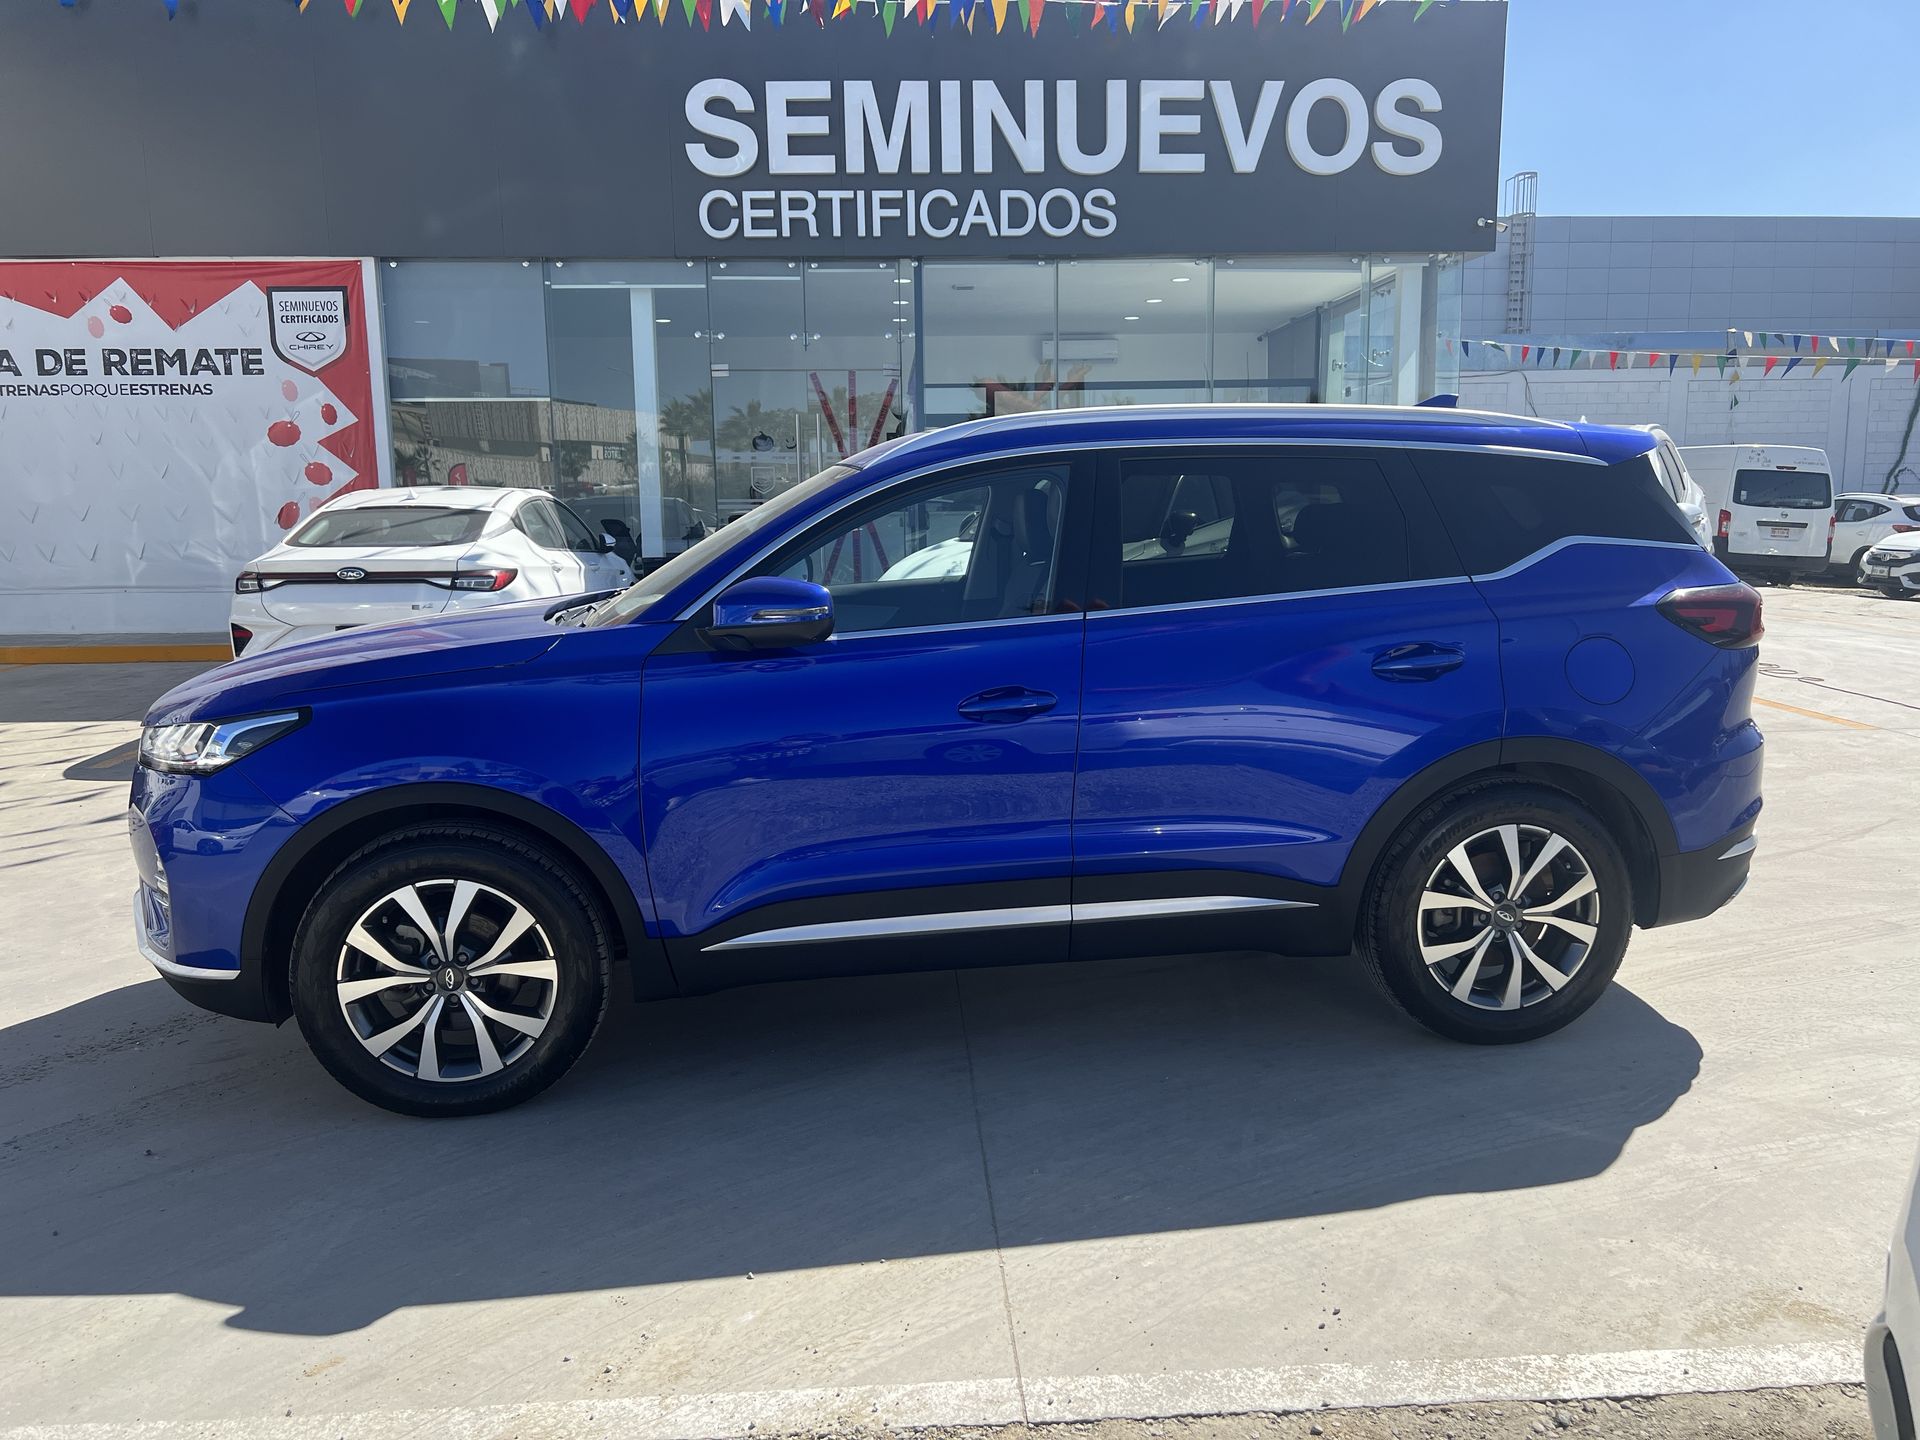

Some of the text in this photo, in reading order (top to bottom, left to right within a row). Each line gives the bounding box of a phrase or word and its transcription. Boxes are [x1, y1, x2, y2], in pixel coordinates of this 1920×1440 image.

[684, 78, 1444, 177] SEMINUEVOS
[698, 188, 1118, 239] CERTIFICADOS
[279, 300, 338, 311] SEMINUEVOS
[280, 315, 339, 323] CERTIFICADOS
[35, 348, 88, 376] DE
[102, 348, 264, 375] REMATE
